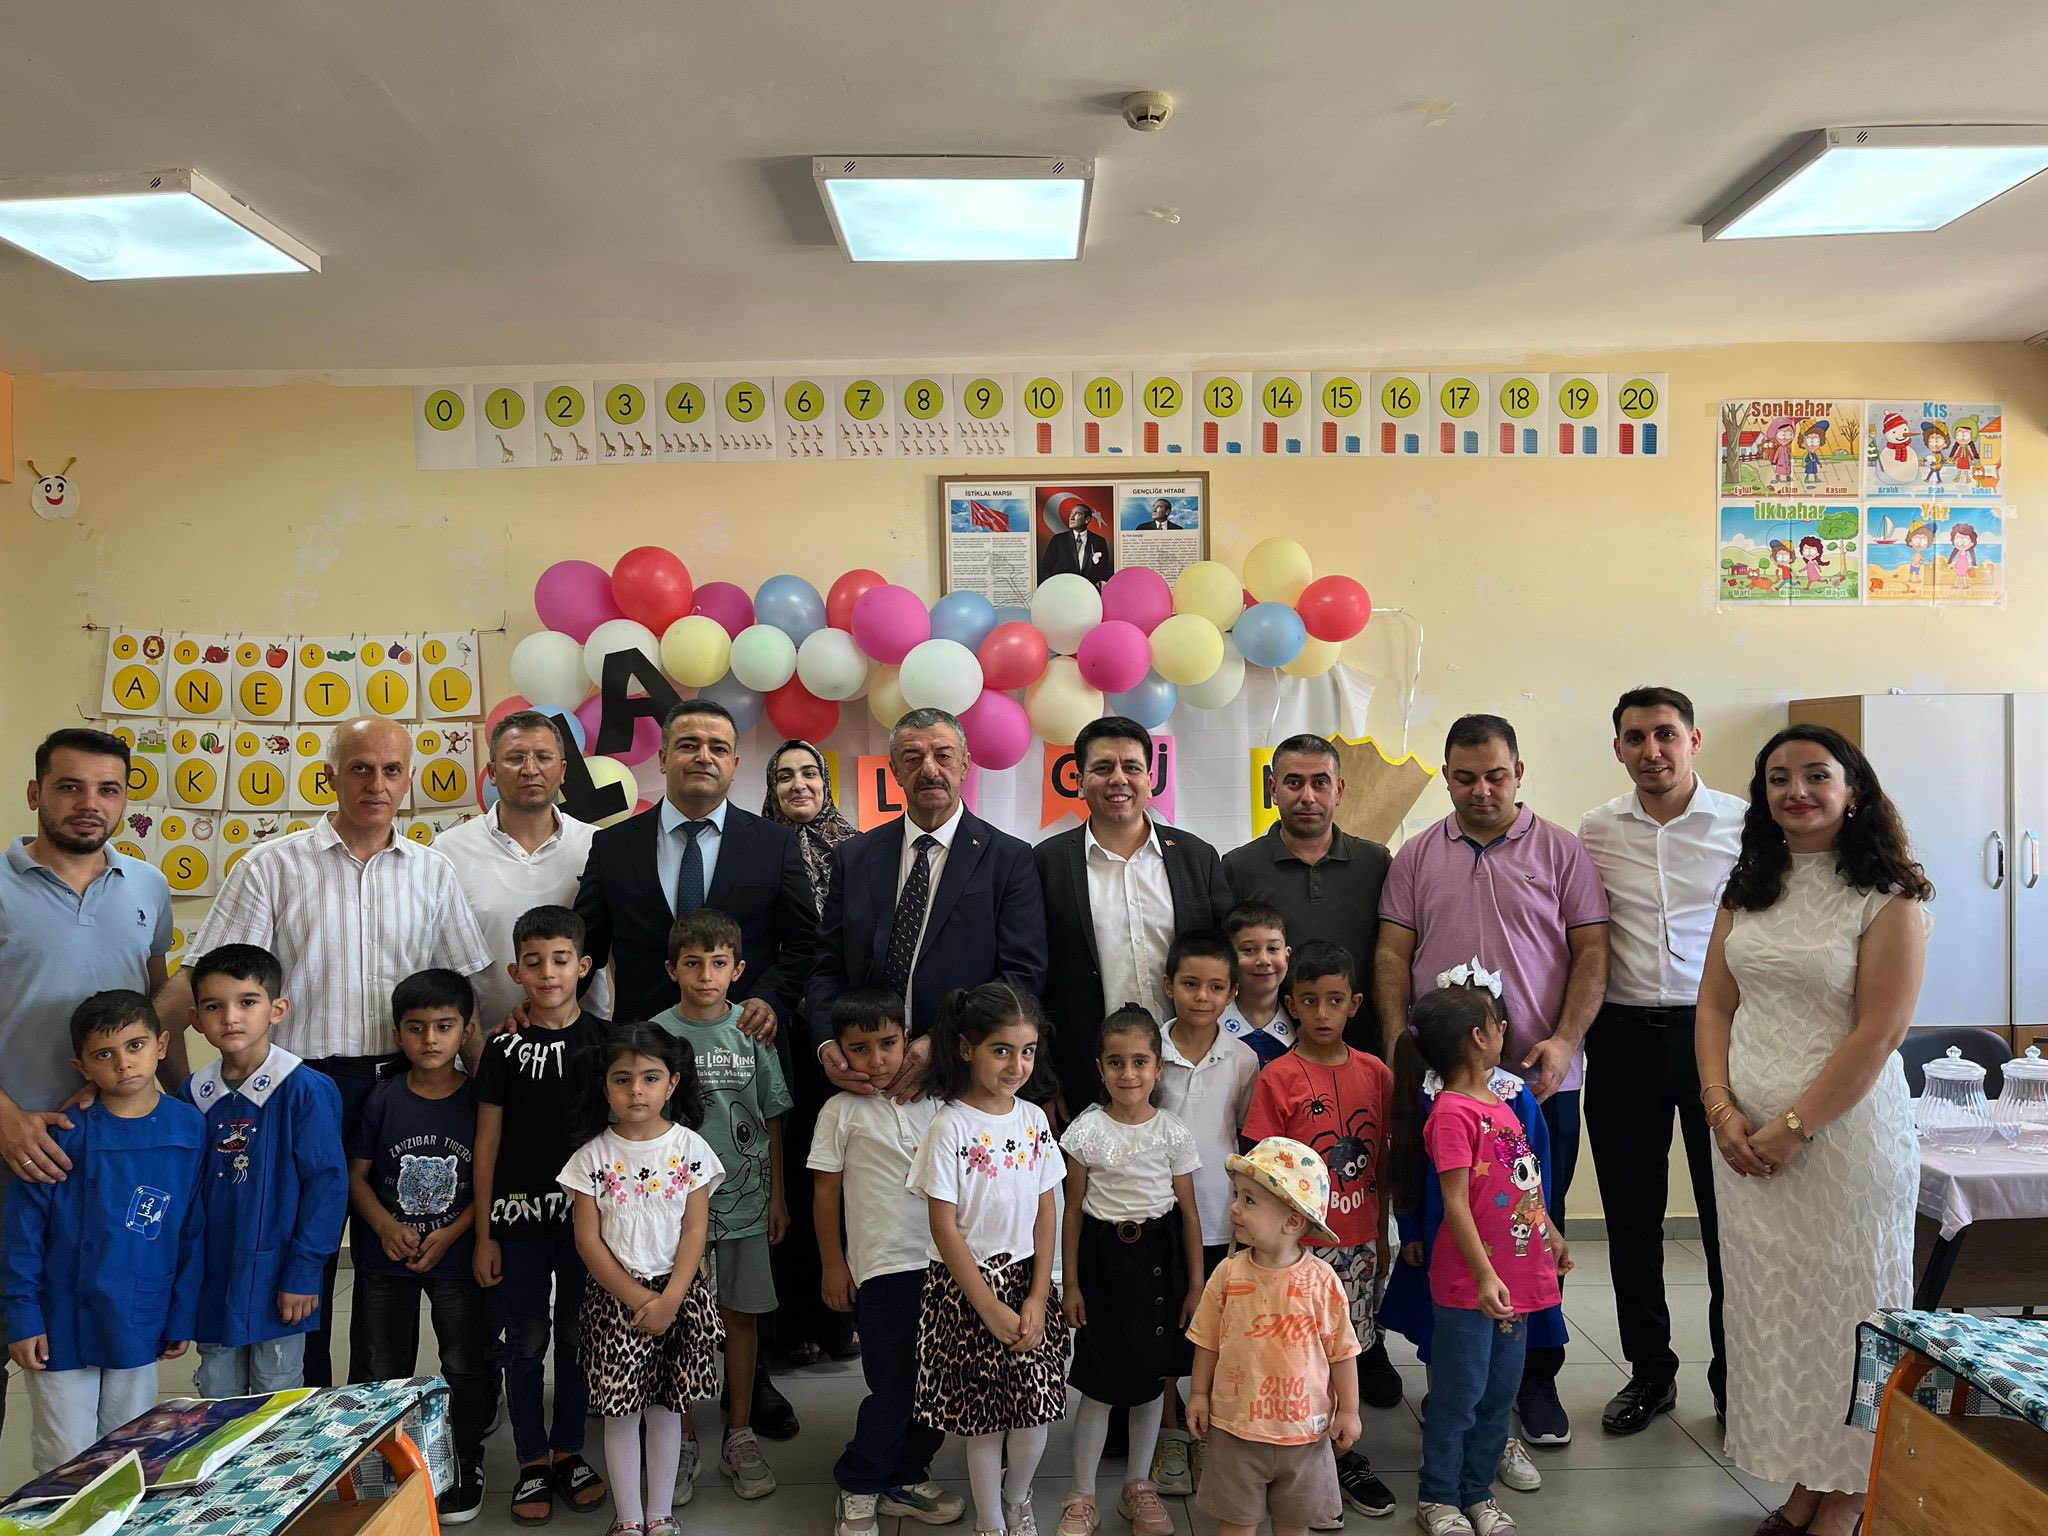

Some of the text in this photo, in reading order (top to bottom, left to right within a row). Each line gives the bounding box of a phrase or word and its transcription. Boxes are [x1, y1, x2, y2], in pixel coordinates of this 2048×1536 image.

[436, 386, 1654, 422] 0 1 2 3 4 5 6 7 8 9 10 11 12 13 14 15 16 17 18 19 20
[1751, 400, 1833, 418] Sonbahar
[1921, 503, 1950, 520] Yaz
[122, 643, 129, 652] a
[183, 649, 190, 657] n
[245, 651, 252, 659] e
[309, 648, 315, 660] t
[125, 676, 146, 700] A
[189, 681, 209, 704] N
[255, 683, 268, 705] E
[319, 683, 335, 706] T
[443, 679, 458, 702] L
[181, 734, 187, 749] k
[243, 741, 251, 749] u
[304, 741, 312, 749] r
[423, 739, 434, 747] m
[127, 767, 457, 795] O K U R M
[170, 824, 423, 839] s ö z
[176, 857, 192, 880] S
[707, 1051, 731, 1068] LION
[388, 1134, 473, 1162] ZANZIBAR TIGERS
[1330, 1187, 1365, 1214] BOO!
[1259, 1376, 1305, 1398] DAYS
[1249, 1394, 1311, 1423] BEACH
[574, 1466, 592, 1478] NIKE
[520, 1478, 545, 1492] NIKE
